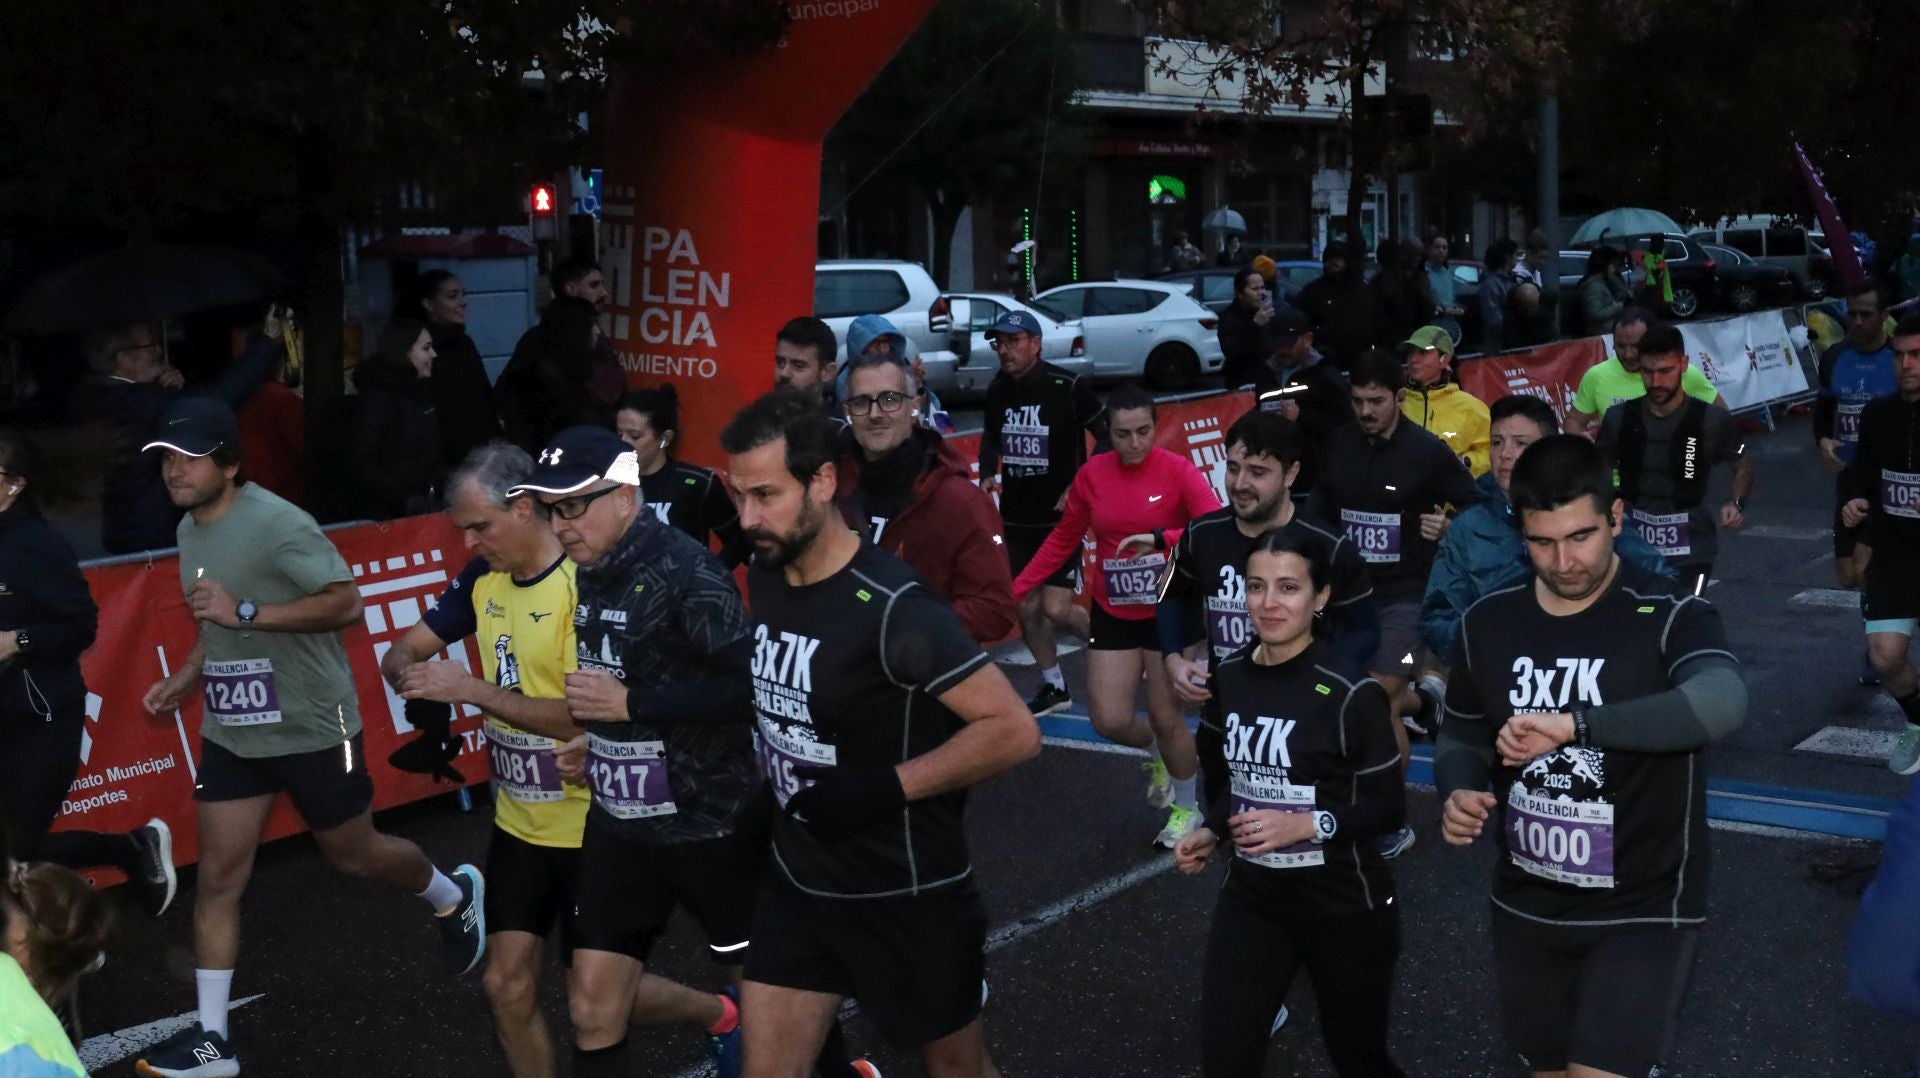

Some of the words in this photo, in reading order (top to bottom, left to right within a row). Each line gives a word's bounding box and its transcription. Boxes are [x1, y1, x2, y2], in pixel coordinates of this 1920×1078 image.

[644, 226, 700, 265] PA
[642, 267, 730, 307] LEN
[640, 307, 717, 347] CIA
[615, 351, 717, 378] AMIENTO
[1004, 405, 1041, 426] 3x7K
[1841, 416, 1860, 432] 11
[1007, 435, 1040, 455] 1136
[1684, 437, 1697, 479] KIPRUN
[1888, 484, 1920, 505] 105
[1356, 513, 1383, 523] PALENCIA
[1346, 525, 1389, 551] 1183
[1638, 523, 1679, 546] 1053
[1110, 569, 1156, 594] 1052
[1218, 564, 1246, 599] 3x
[1230, 600, 1248, 610] PALE
[1218, 615, 1257, 645] 105
[214, 663, 249, 673] PALENCIA
[751, 623, 821, 693] 3x7K
[205, 680, 268, 710] 1240
[1509, 656, 1605, 708] 3x7K
[754, 687, 813, 725] PALENCIA
[496, 733, 530, 747] PALENCIA
[600, 742, 637, 757] PALENCIA
[768, 731, 806, 757] PALENCIA
[1223, 712, 1296, 768] 3x7K
[106, 753, 175, 783] Municipal
[491, 745, 541, 785] 1081
[590, 759, 649, 799] 1217
[1247, 784, 1285, 800] PALENCIA
[1543, 774, 1572, 790] 2025
[62, 789, 128, 816] Deportes
[1529, 799, 1580, 818] PALENCIA
[1513, 816, 1591, 866] 1000
